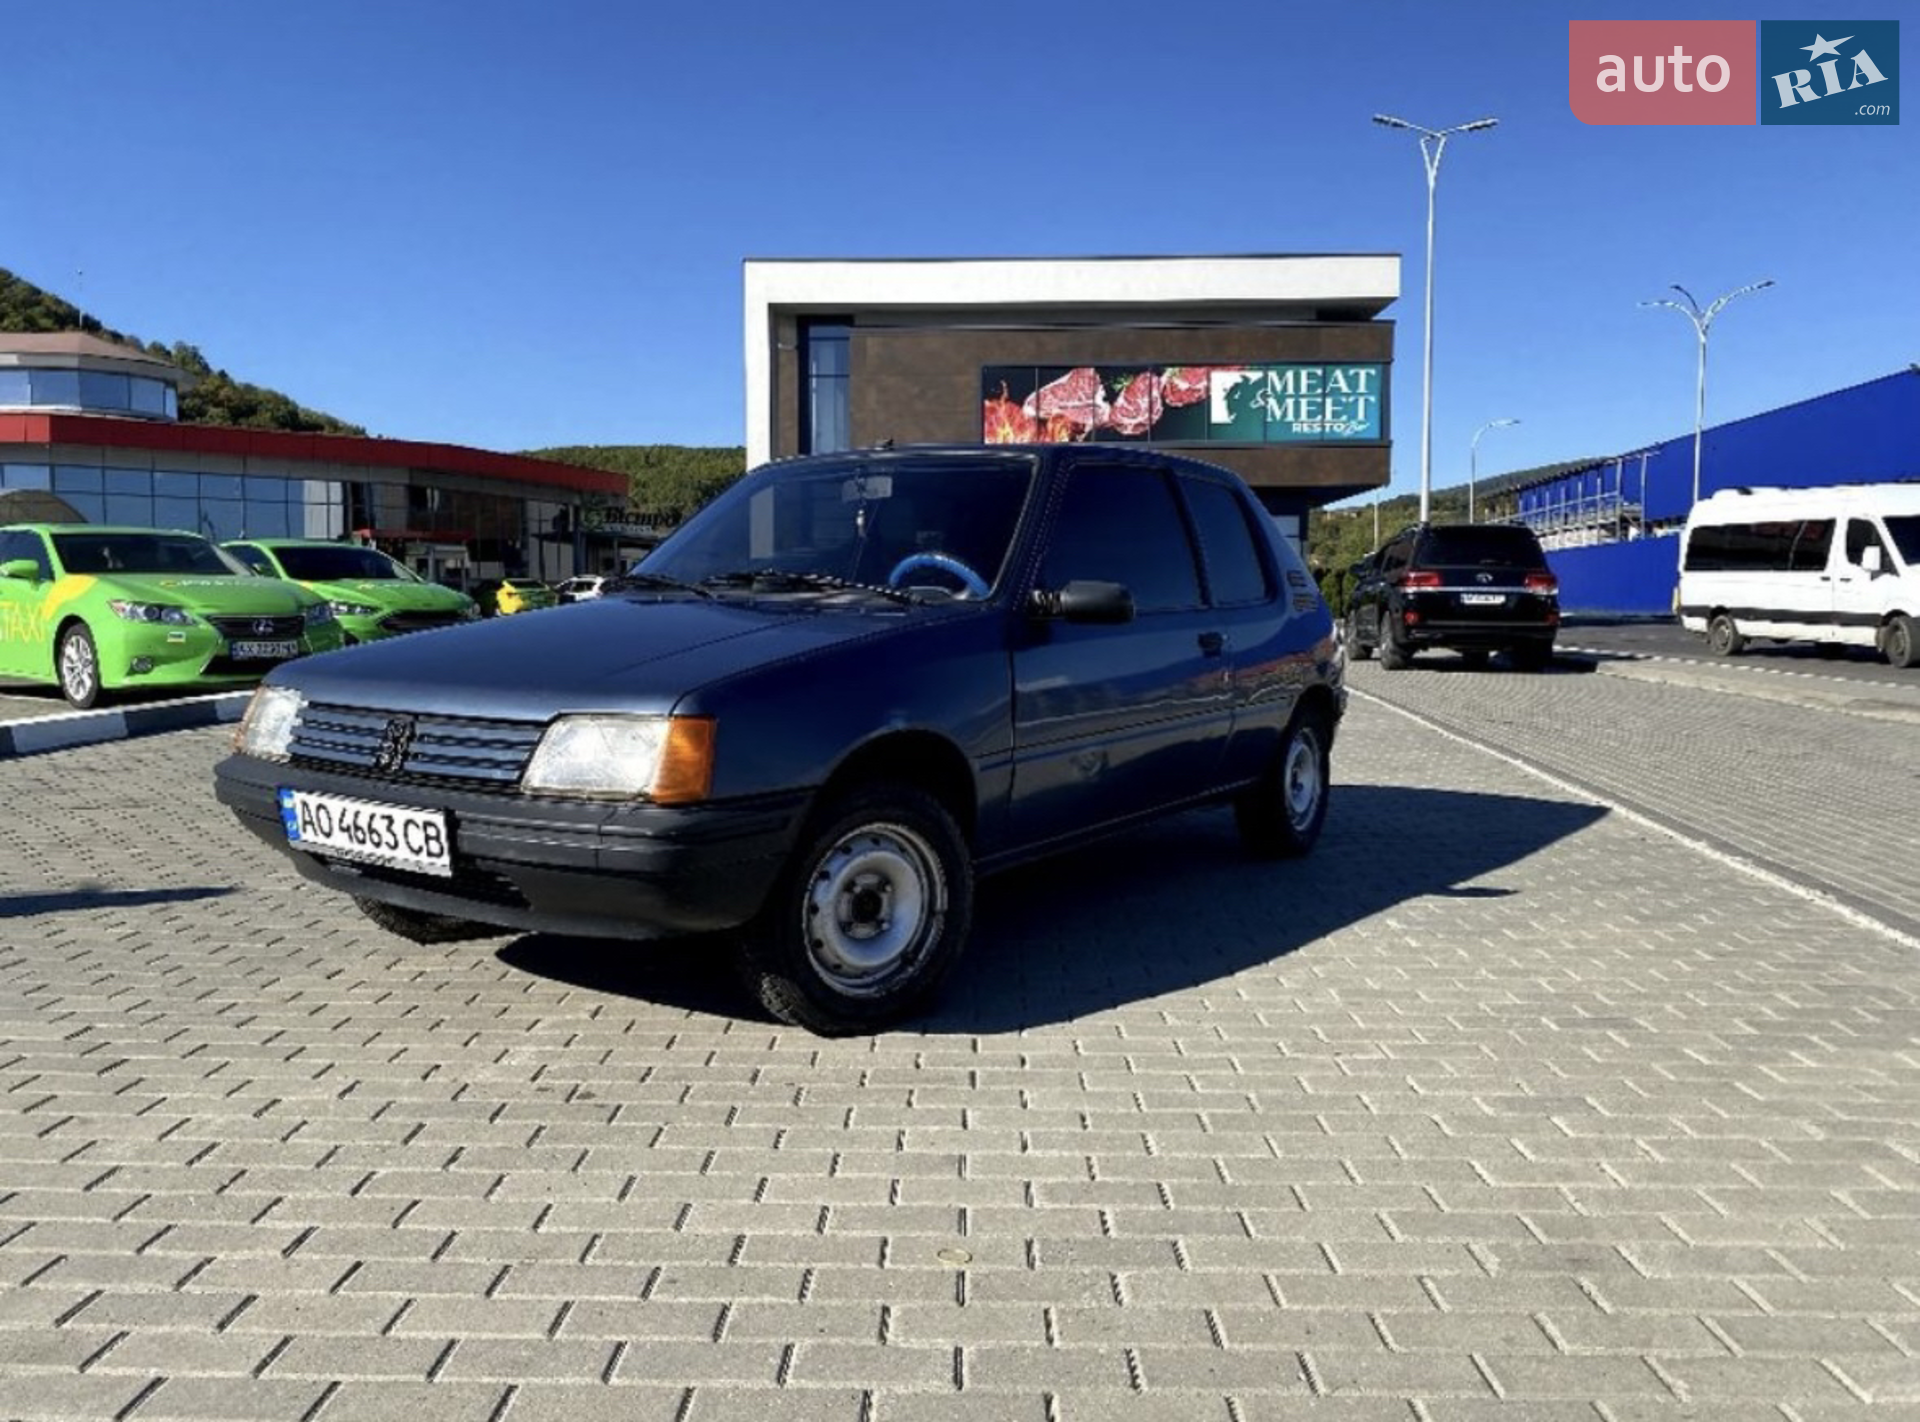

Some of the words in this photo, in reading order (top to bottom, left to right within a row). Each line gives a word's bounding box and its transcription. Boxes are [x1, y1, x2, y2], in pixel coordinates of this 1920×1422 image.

[1267, 369, 1376, 395] MEAT
[1266, 396, 1376, 422] MEET
[0, 600, 46, 643] TAXI
[301, 800, 333, 838] AO
[338, 807, 399, 850] 4663
[403, 818, 444, 858] CB
